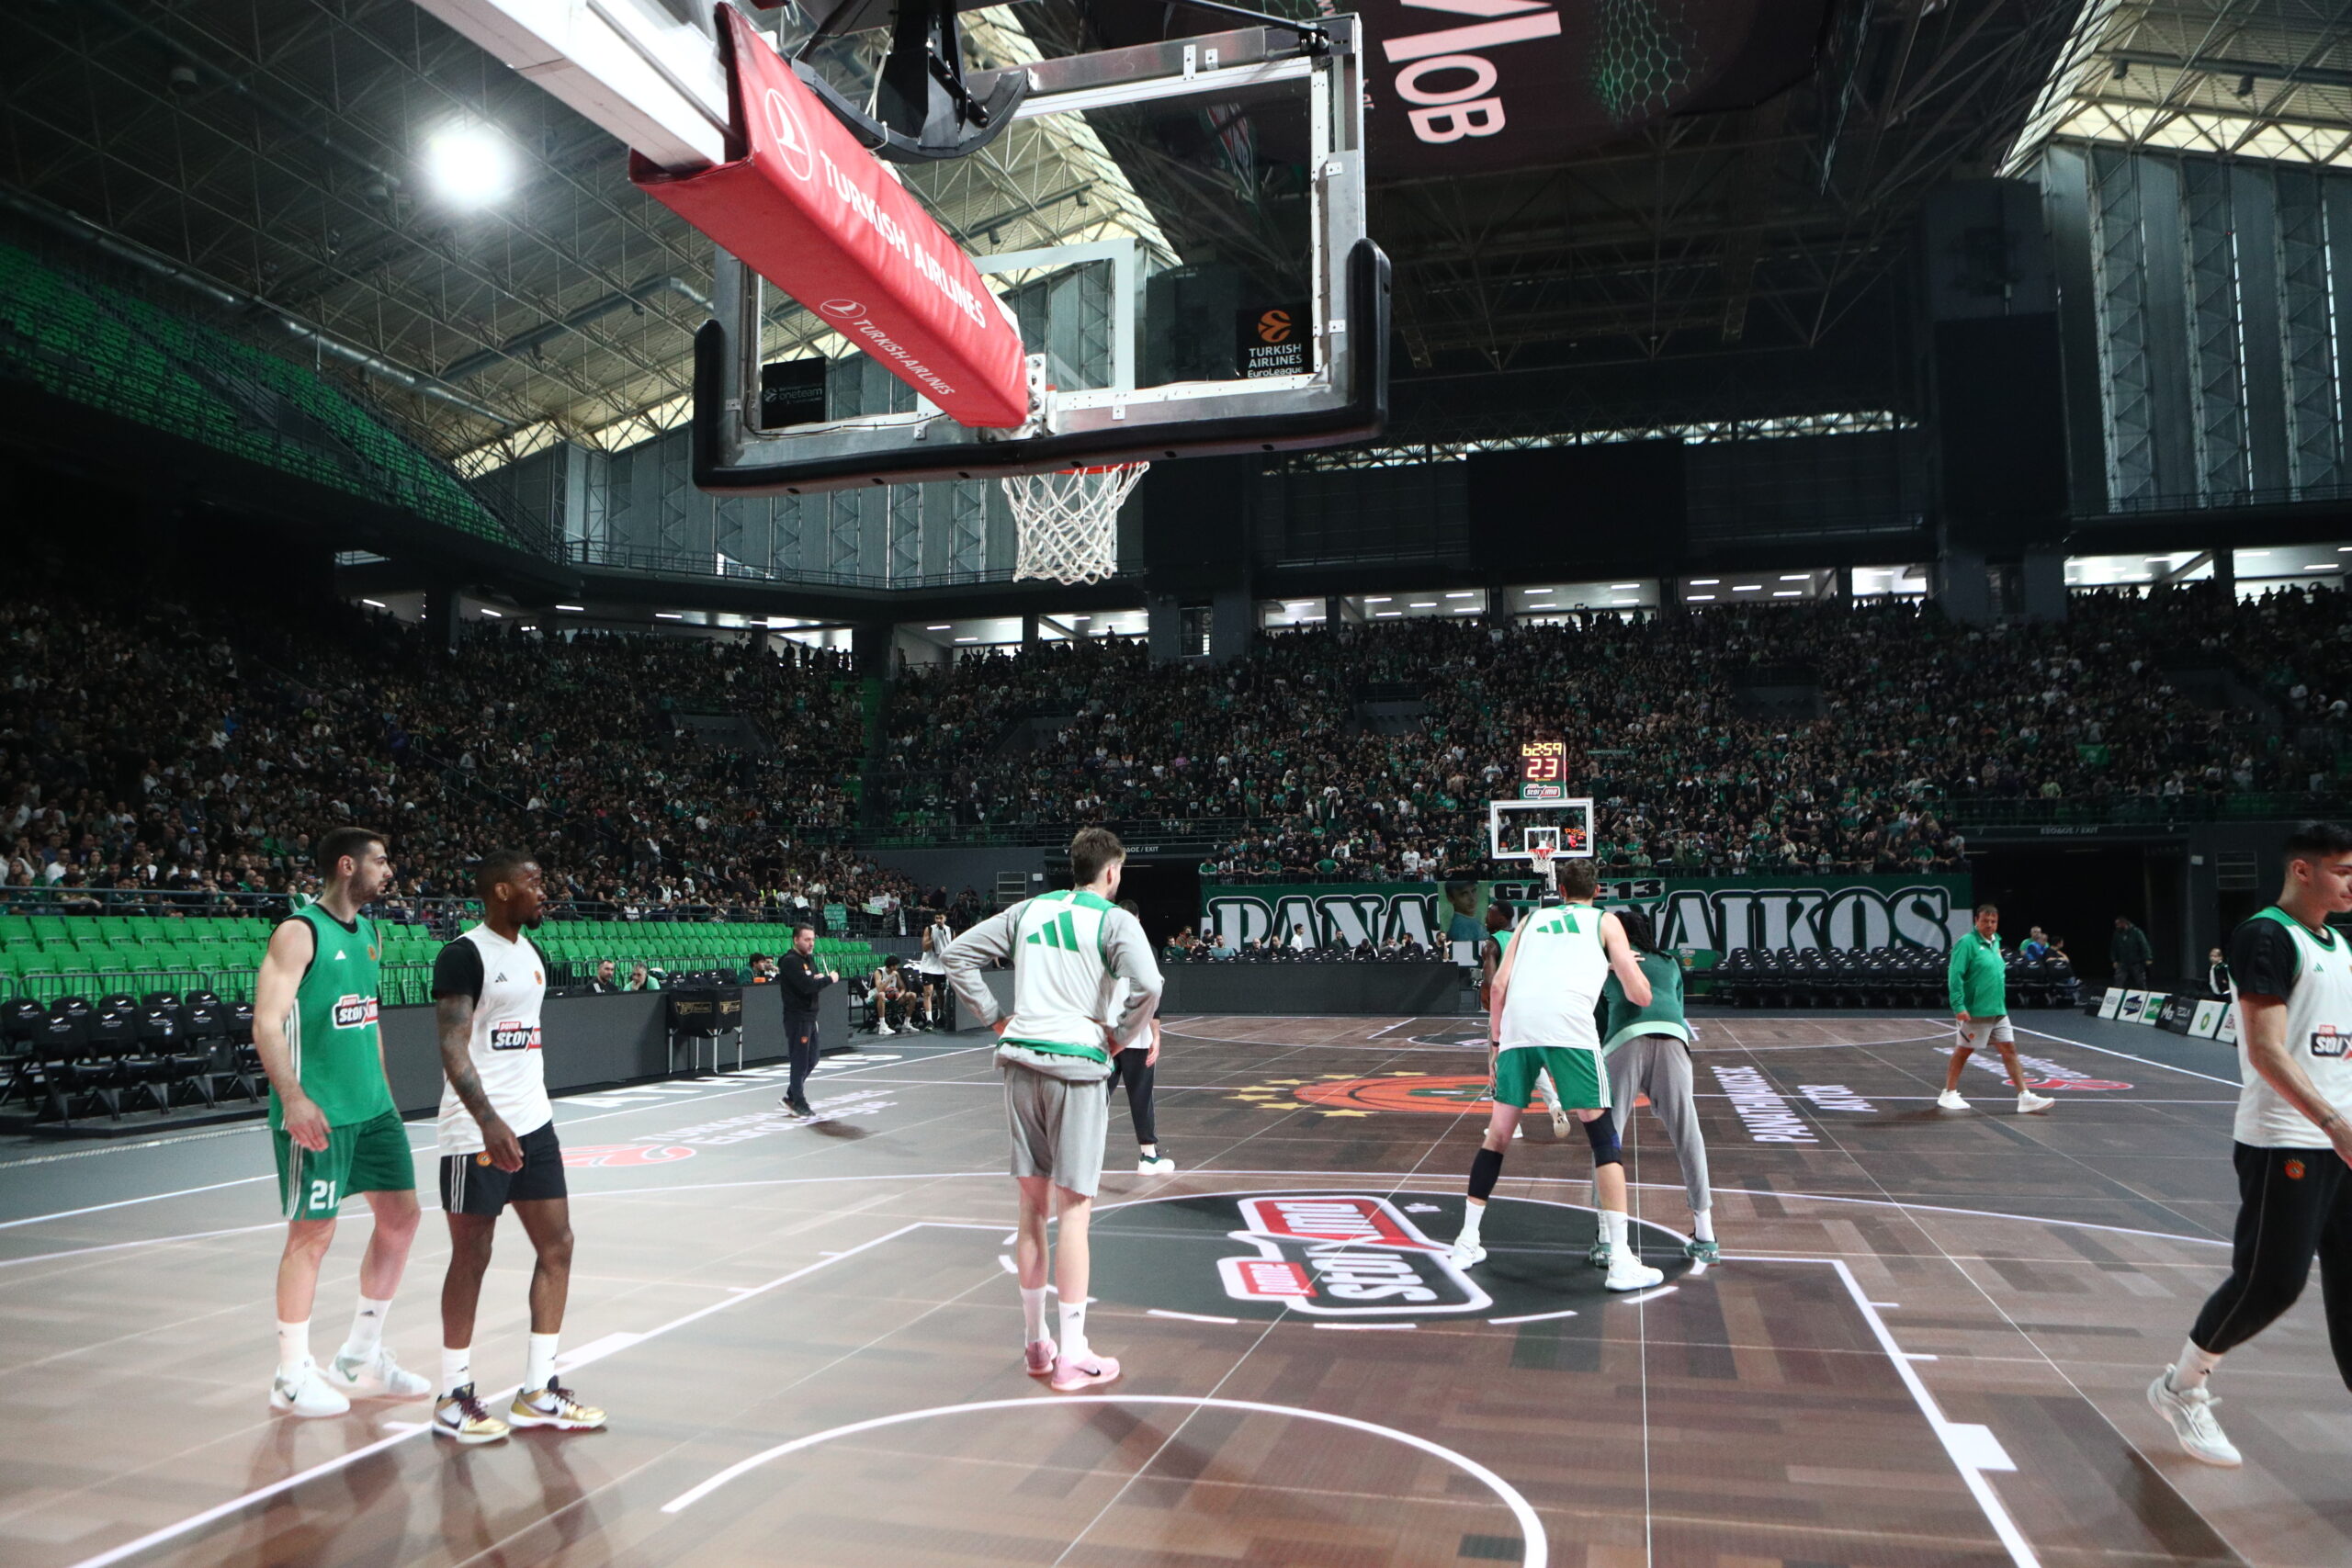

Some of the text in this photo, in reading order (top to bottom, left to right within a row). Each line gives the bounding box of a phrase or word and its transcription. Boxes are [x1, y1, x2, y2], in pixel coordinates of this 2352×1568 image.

[819, 149, 987, 329] TURKISH AIRLINES
[853, 319, 956, 395] TURKISH AIRLINES
[1248, 354, 1303, 368] AIRLINES
[1249, 344, 1302, 358] TURKISH
[1247, 366, 1304, 378] EuroLeague
[1527, 758, 1559, 778] 23
[1614, 879, 1662, 900] 13
[1796, 1084, 1879, 1112] AKTOR
[309, 1179, 337, 1211] 21
